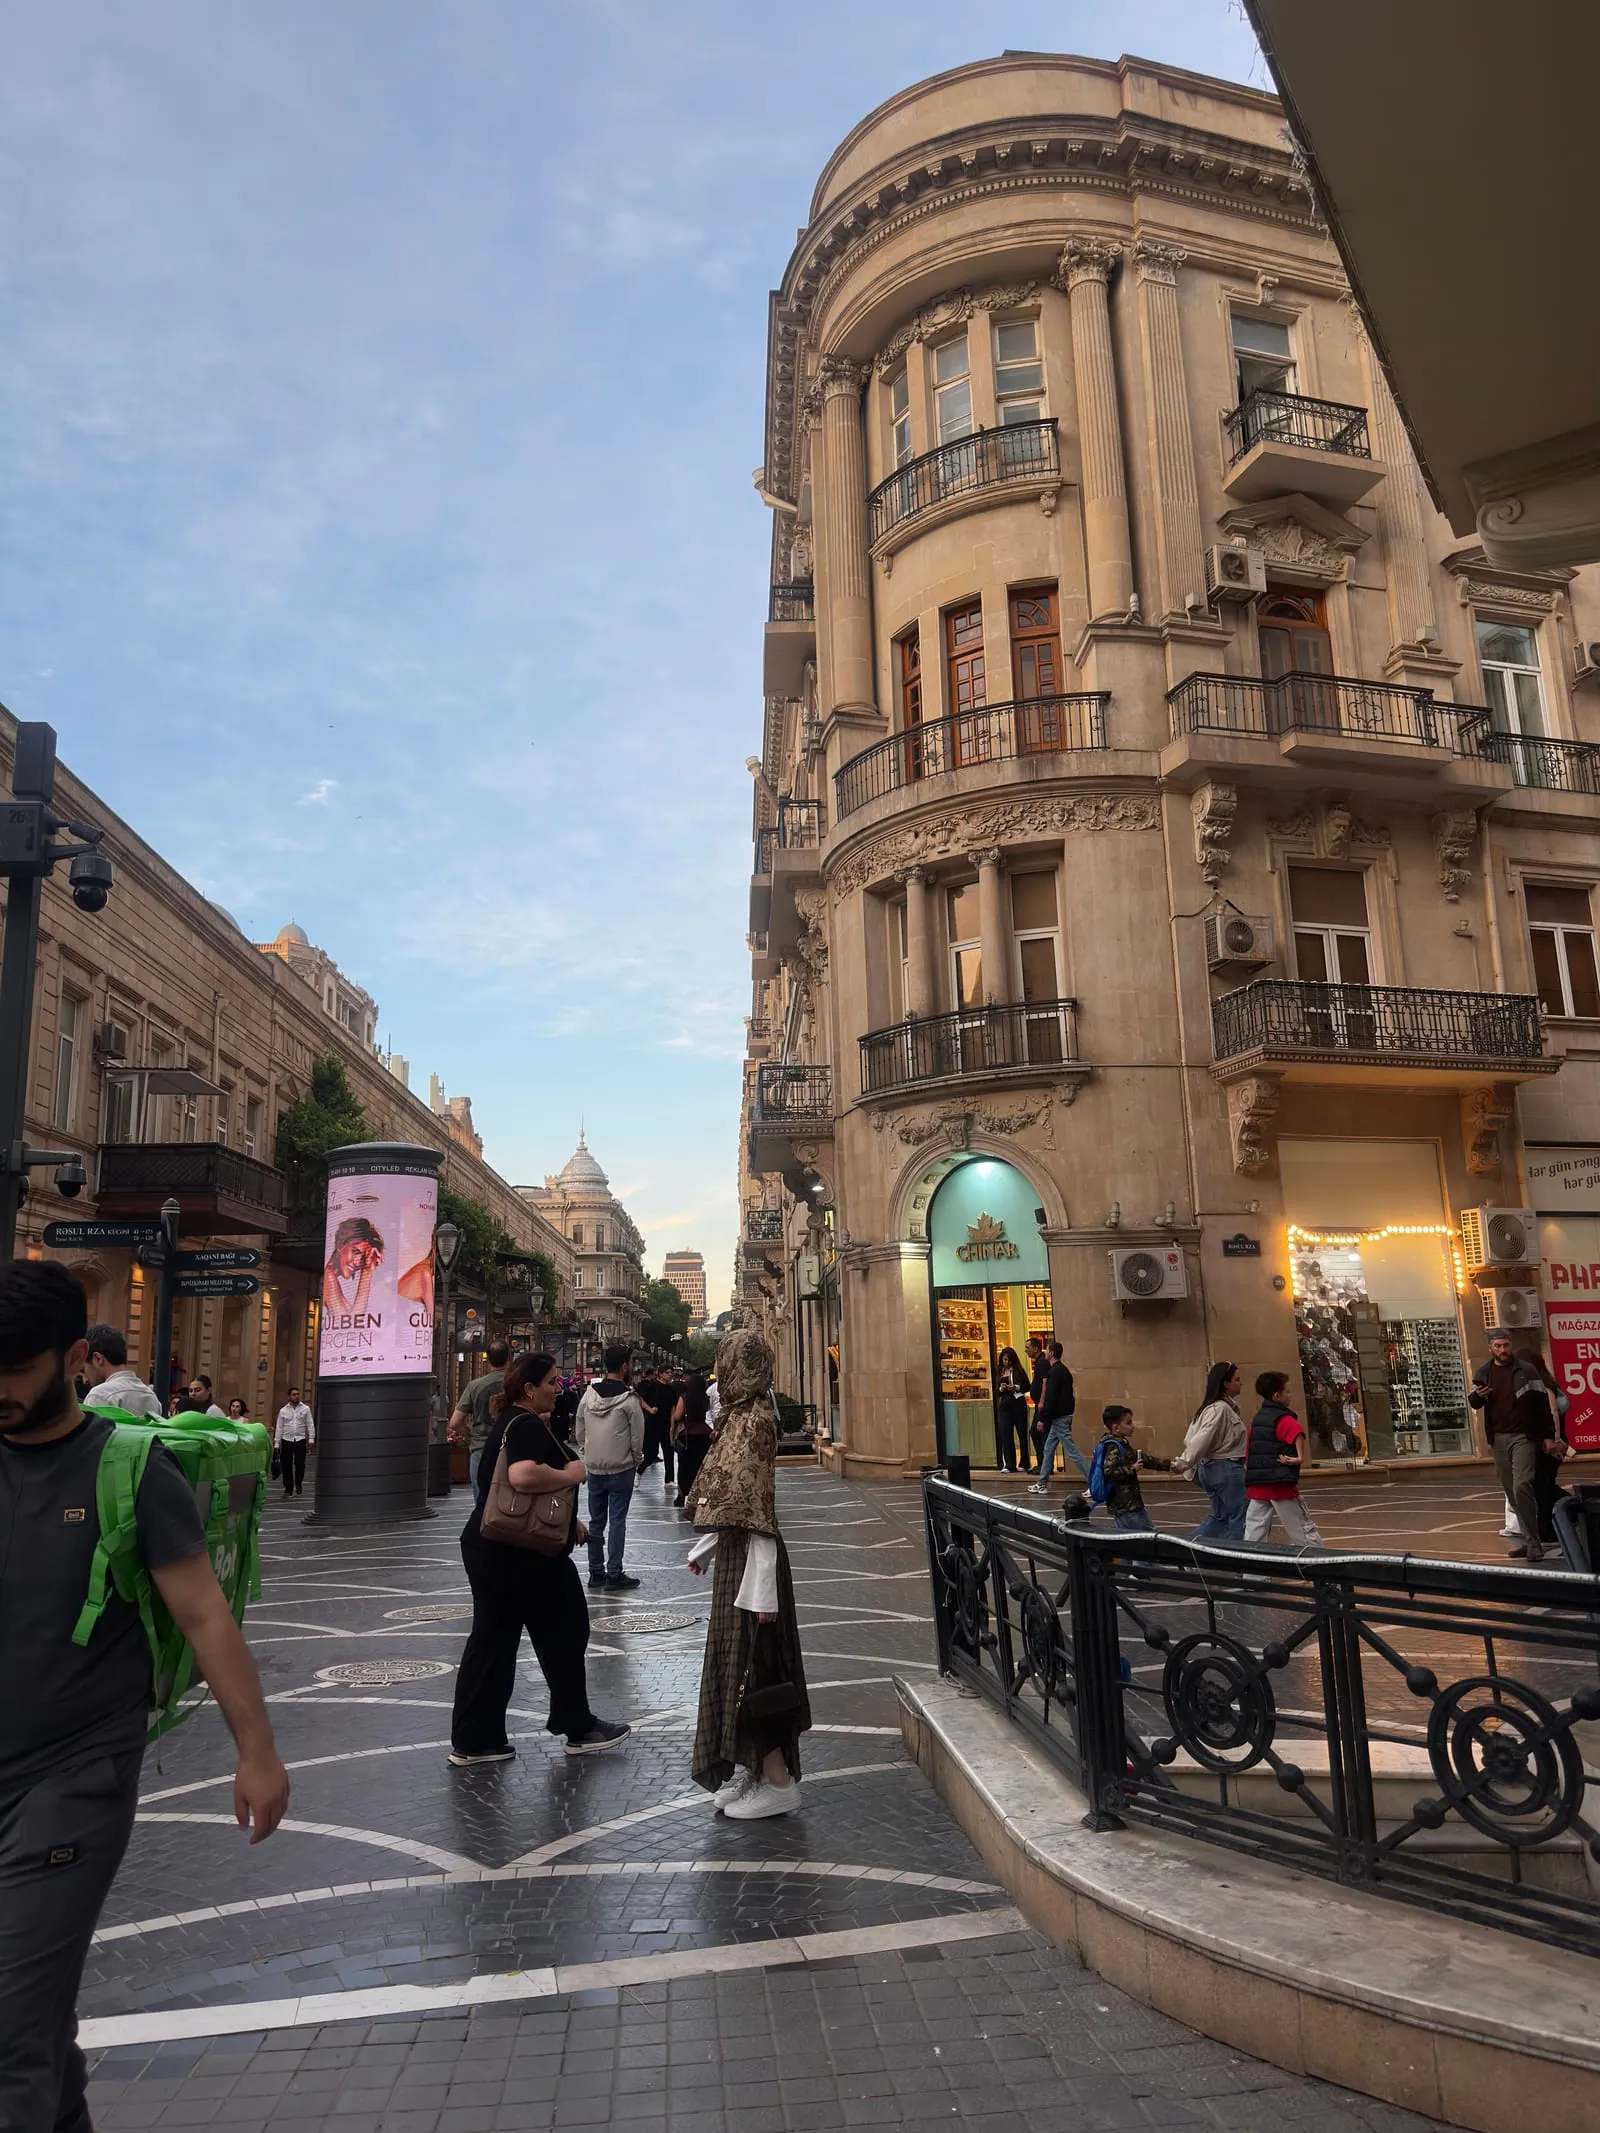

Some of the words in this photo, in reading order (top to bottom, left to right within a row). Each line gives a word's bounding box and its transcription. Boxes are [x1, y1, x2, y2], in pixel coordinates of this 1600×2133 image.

[1548, 1160, 1571, 1177] gün
[1563, 1177, 1584, 1190] hər
[56, 1227, 85, 1236] RƏSUL
[87, 1227, 105, 1236] RZA
[220, 1251, 236, 1260] BAĞI
[956, 1242, 1018, 1262] CHINAR
[321, 1311, 382, 1331] ÜLBEN
[321, 1331, 373, 1348] RGEN
[1574, 1407, 1594, 1426] SALE
[1575, 1435, 1597, 1443] STORE
